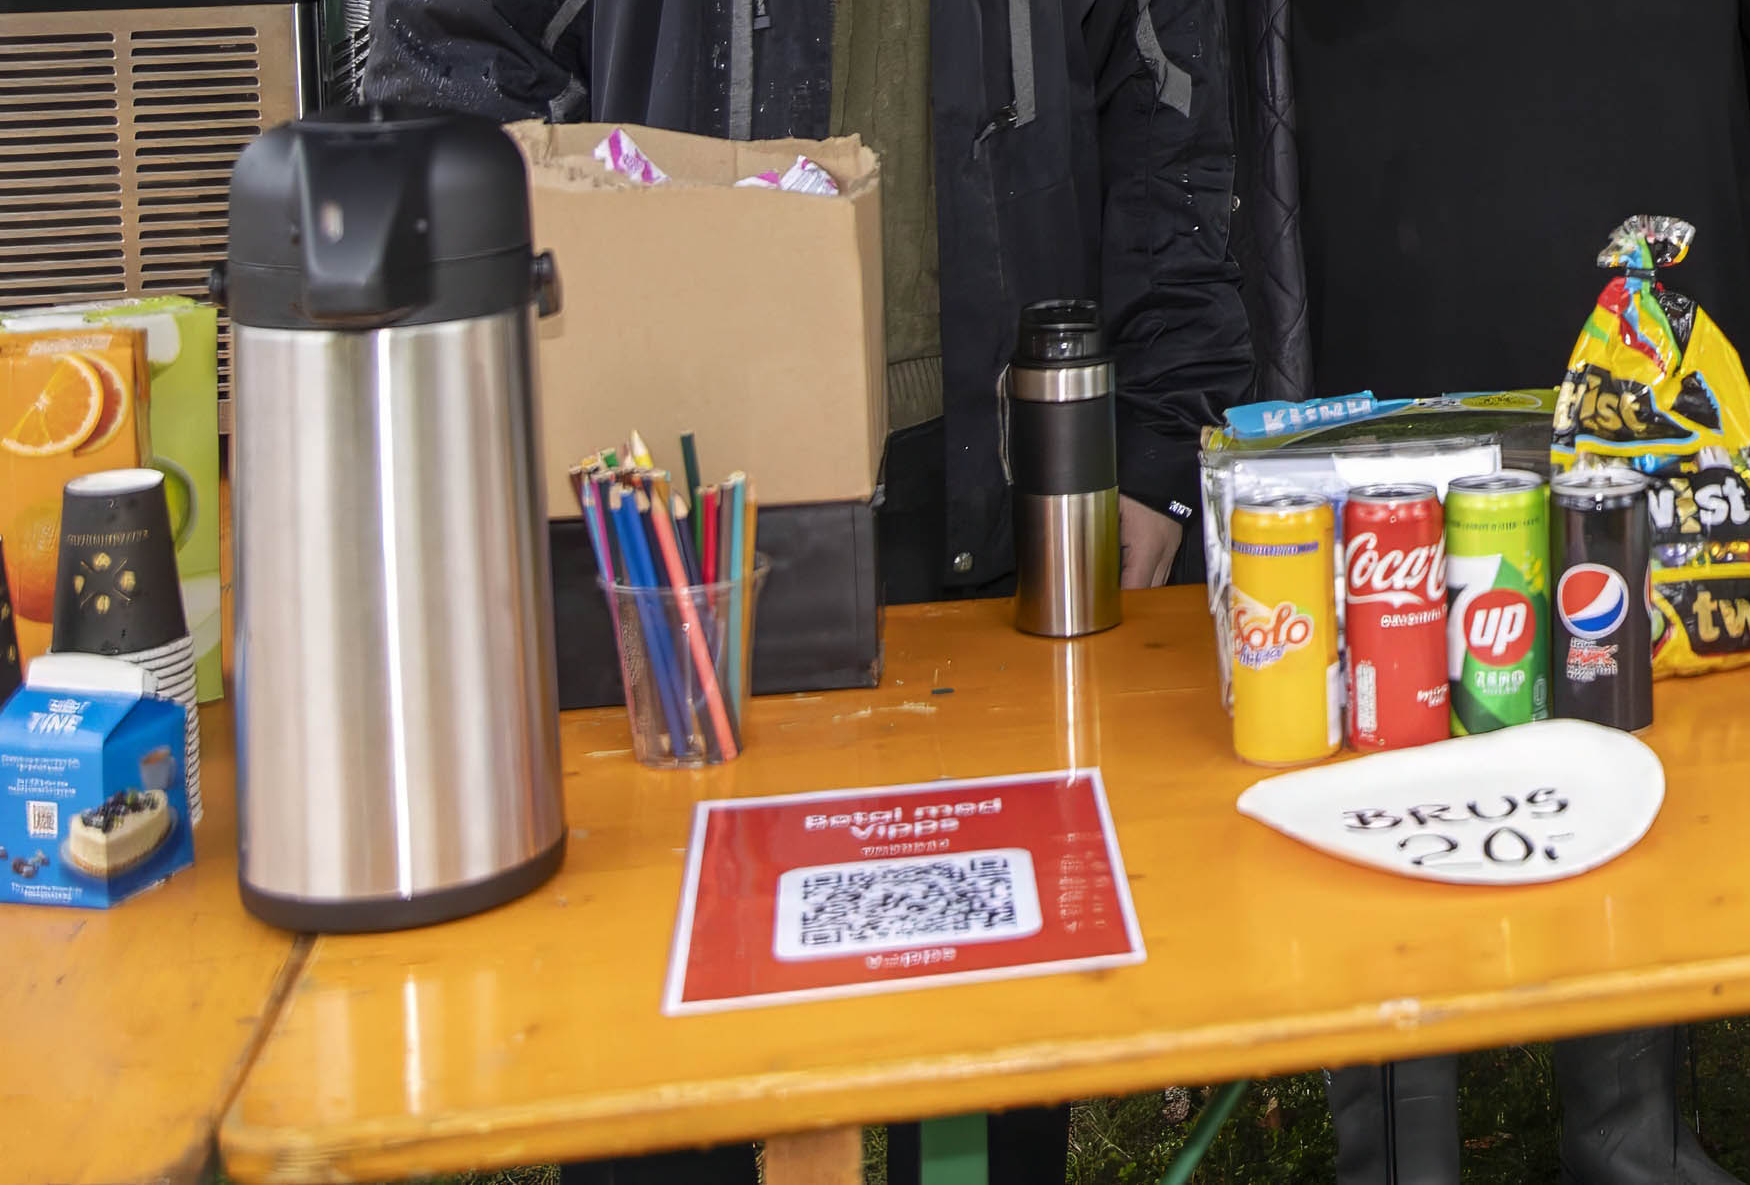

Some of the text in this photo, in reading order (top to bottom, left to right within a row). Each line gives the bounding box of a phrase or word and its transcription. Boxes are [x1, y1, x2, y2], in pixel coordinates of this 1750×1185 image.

[914, 797, 1003, 821] med
[1342, 787, 1569, 830] BRUS
[850, 817, 960, 840] Vipps
